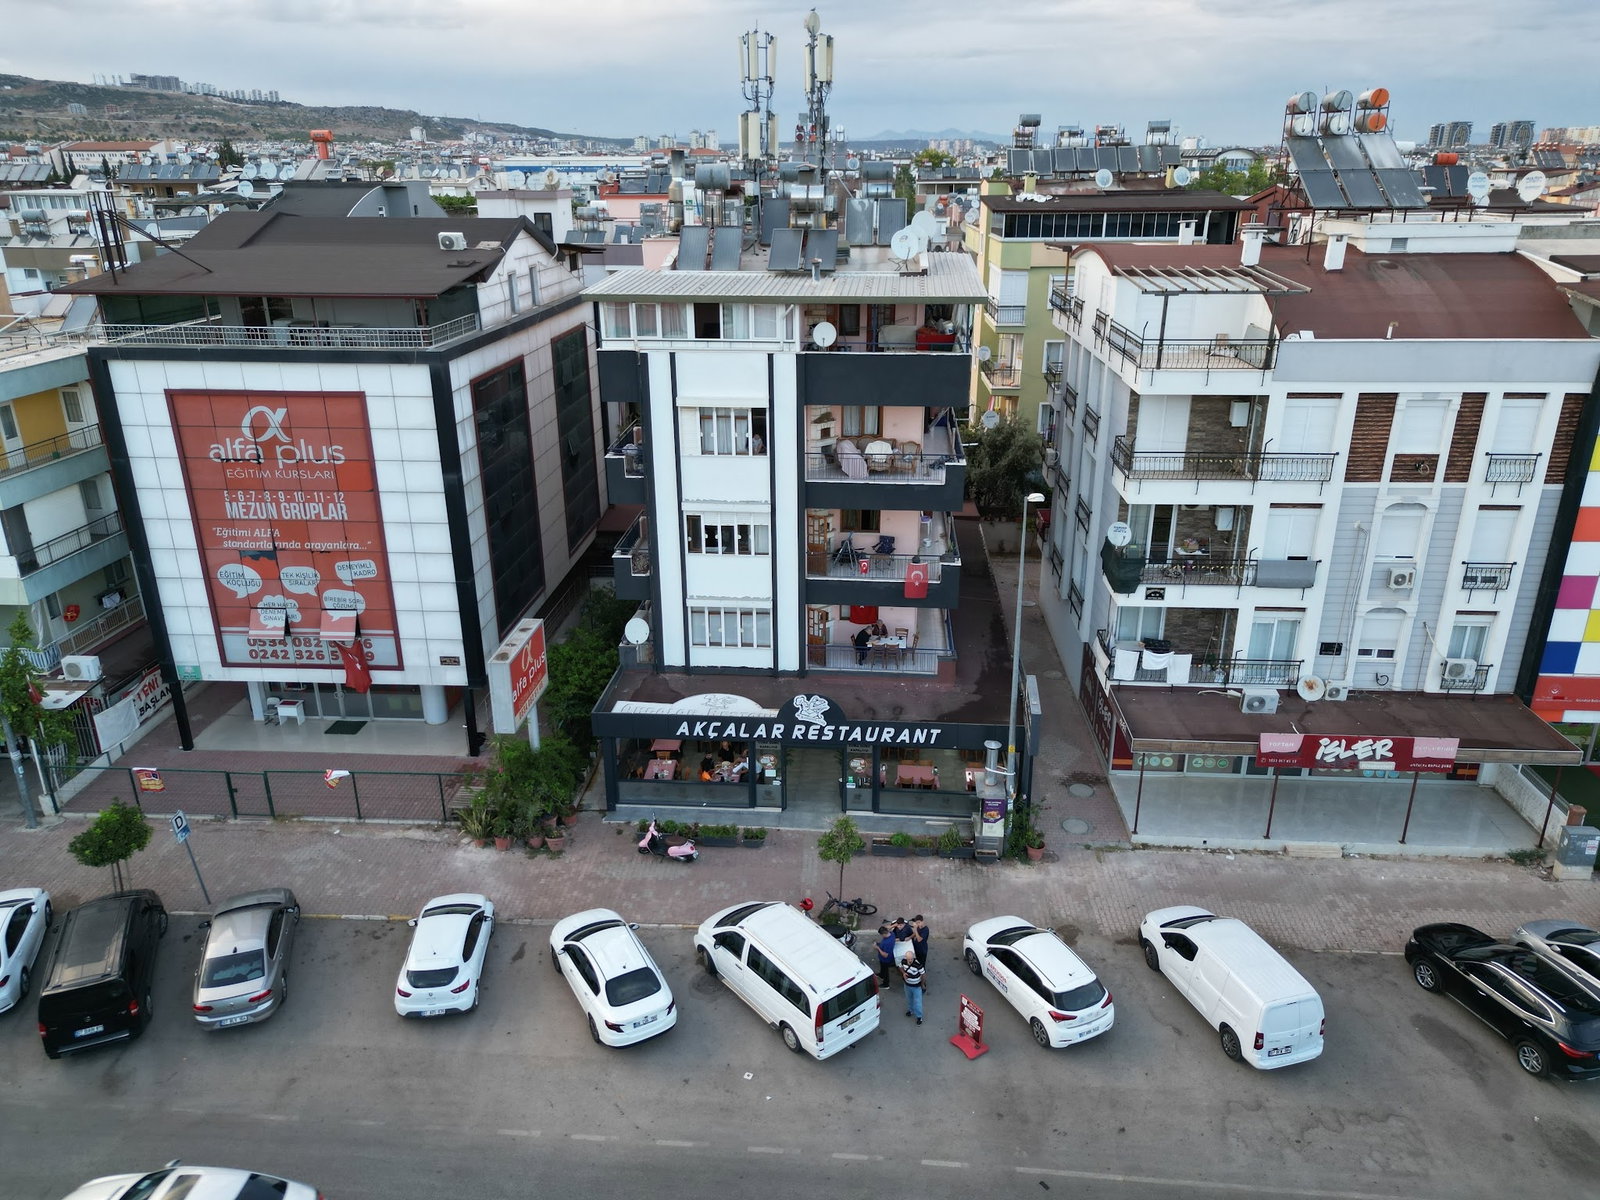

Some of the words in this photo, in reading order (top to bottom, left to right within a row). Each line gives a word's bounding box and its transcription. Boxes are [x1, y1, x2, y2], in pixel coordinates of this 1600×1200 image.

[209, 437, 264, 464] alfa
[275, 438, 346, 469] plus
[275, 469, 335, 480] KURSLARI
[225, 502, 278, 520] MEZUN
[281, 502, 348, 521] GRUPLAR
[353, 569, 376, 577] KADRO
[248, 649, 290, 660] 0242
[294, 649, 325, 661] 326
[512, 677, 527, 703] alfa
[529, 650, 545, 683] plus
[676, 721, 786, 740] AKÇALAR
[791, 725, 942, 745] RESTAURANT
